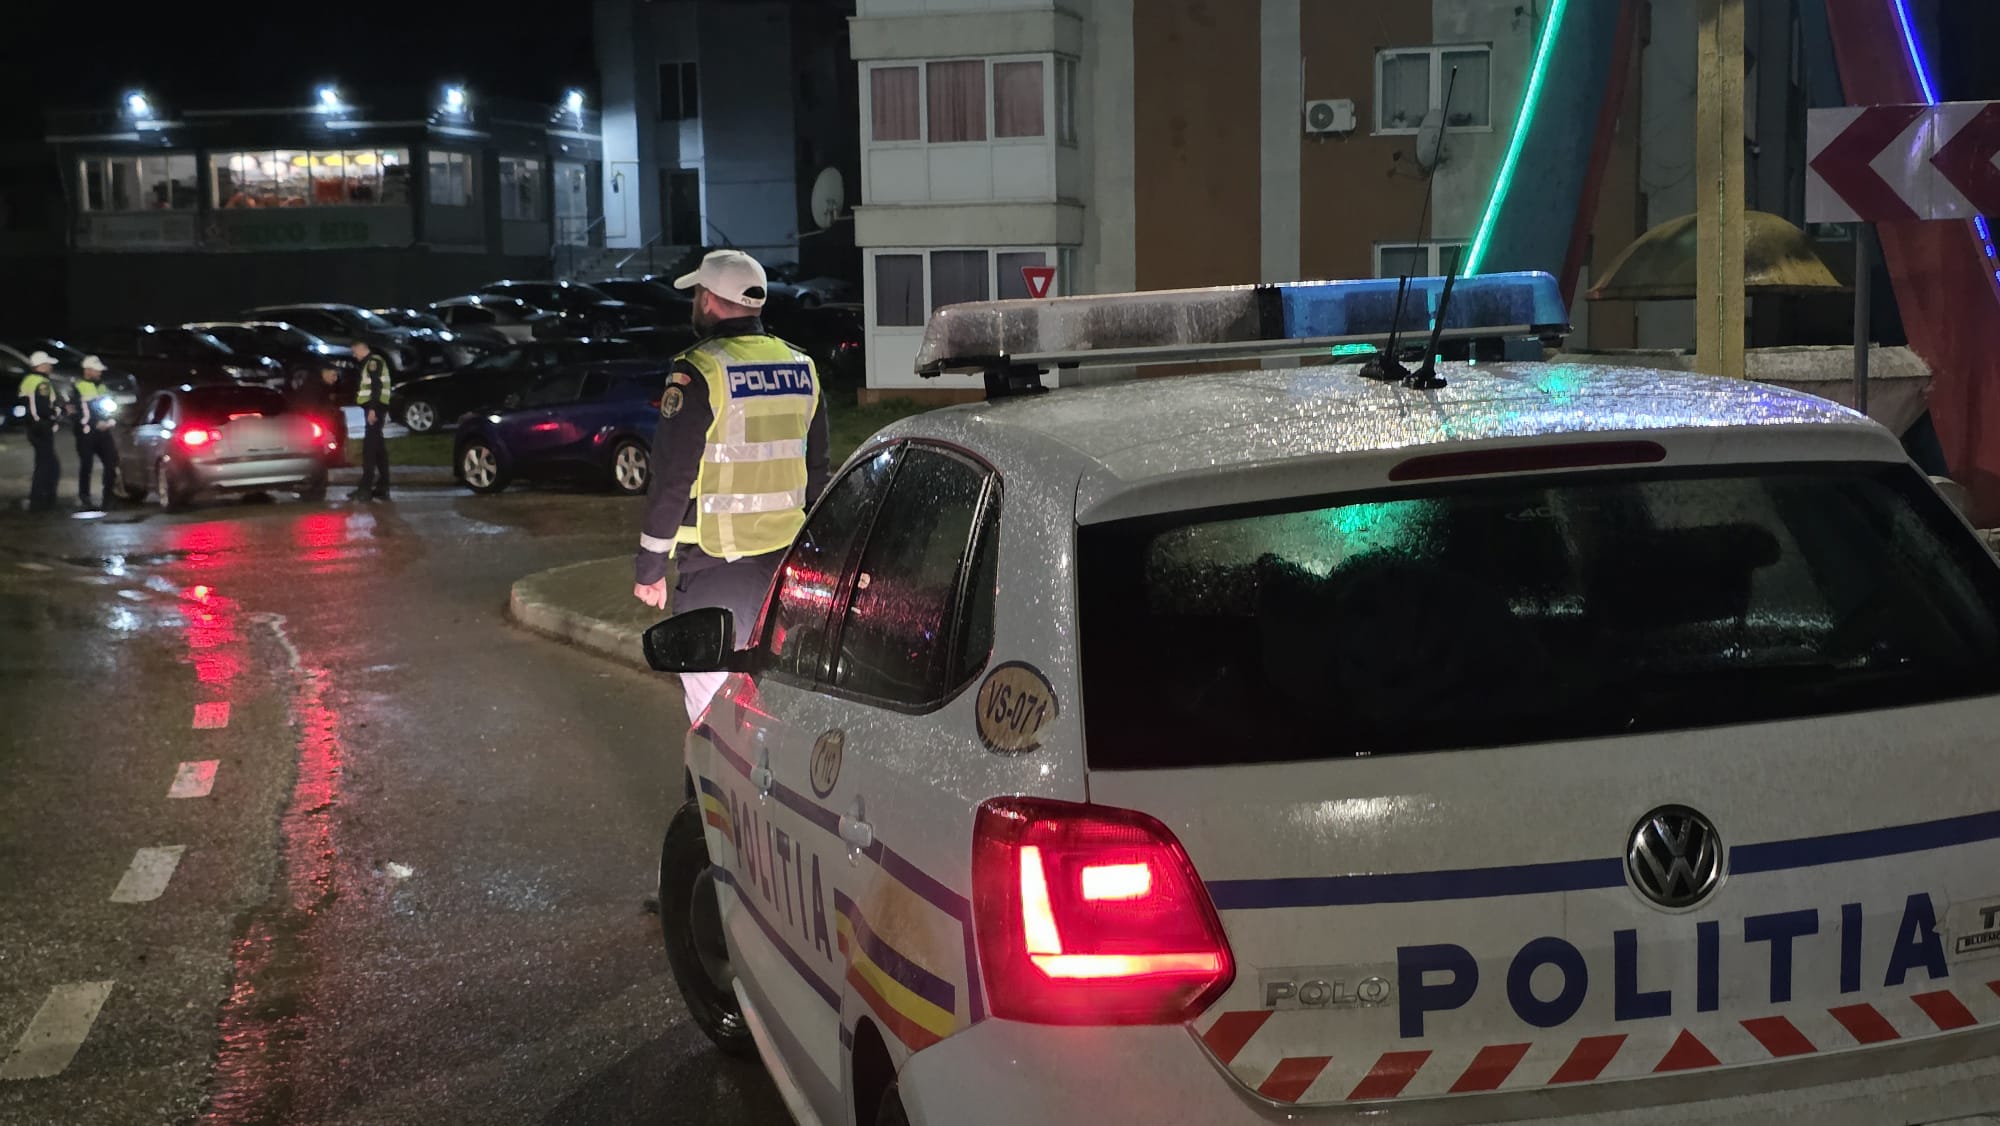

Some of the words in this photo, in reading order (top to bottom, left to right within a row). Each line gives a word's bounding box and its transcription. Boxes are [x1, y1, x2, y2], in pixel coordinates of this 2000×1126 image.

[729, 369, 812, 392] POLITIA
[987, 680, 1047, 735] VS-071
[730, 788, 834, 963] POLITIA
[1630, 808, 1720, 903] VW
[1979, 904, 2000, 930] T
[1266, 977, 1391, 1007] POLO
[1396, 892, 1950, 1038] POLITIA
